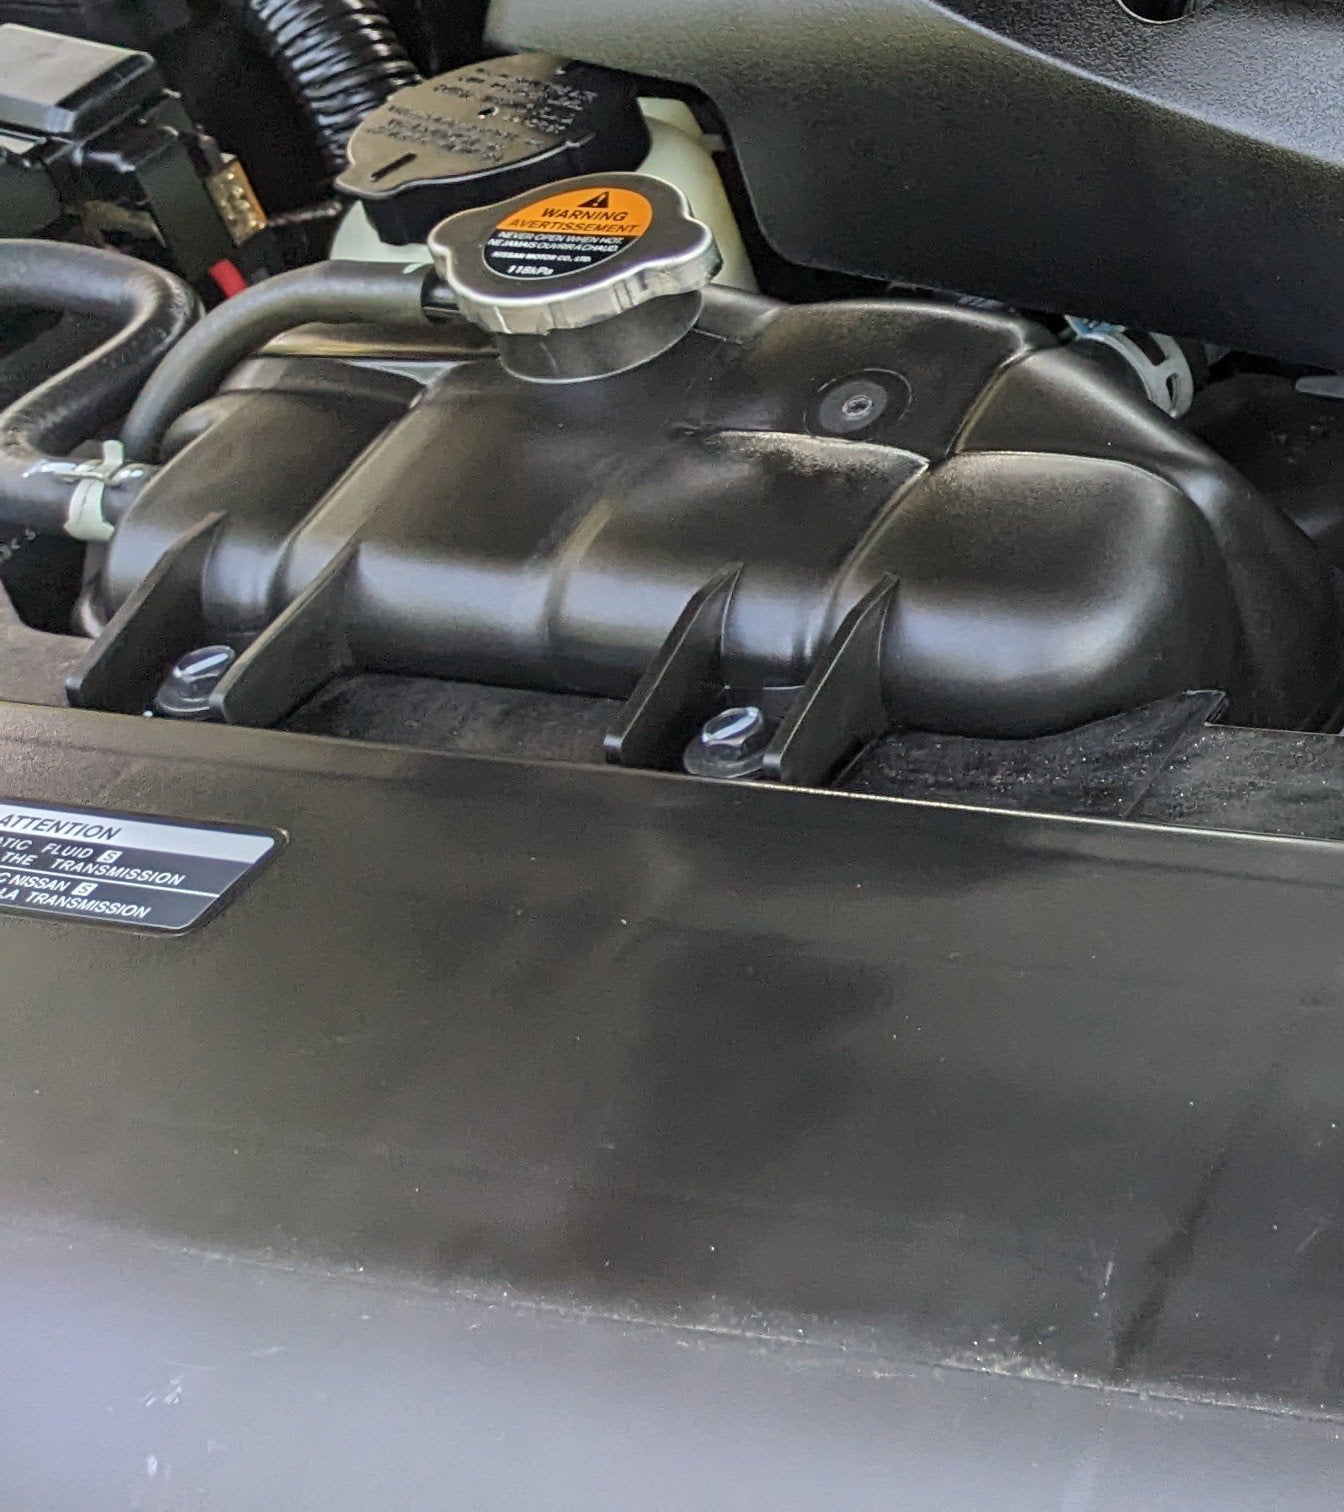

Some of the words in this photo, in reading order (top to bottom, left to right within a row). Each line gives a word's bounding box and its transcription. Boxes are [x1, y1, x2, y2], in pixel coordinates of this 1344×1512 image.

[541, 207, 628, 221] WARNING
[508, 219, 639, 233] AVERTISSEMENT
[0, 813, 122, 841] ATTENTION
[41, 843, 94, 859] FLUID
[1, 852, 39, 866] THE
[51, 858, 186, 886] TRANSMISSION
[8, 873, 72, 893] NISSAN
[26, 891, 151, 918] TRANSMISSION
